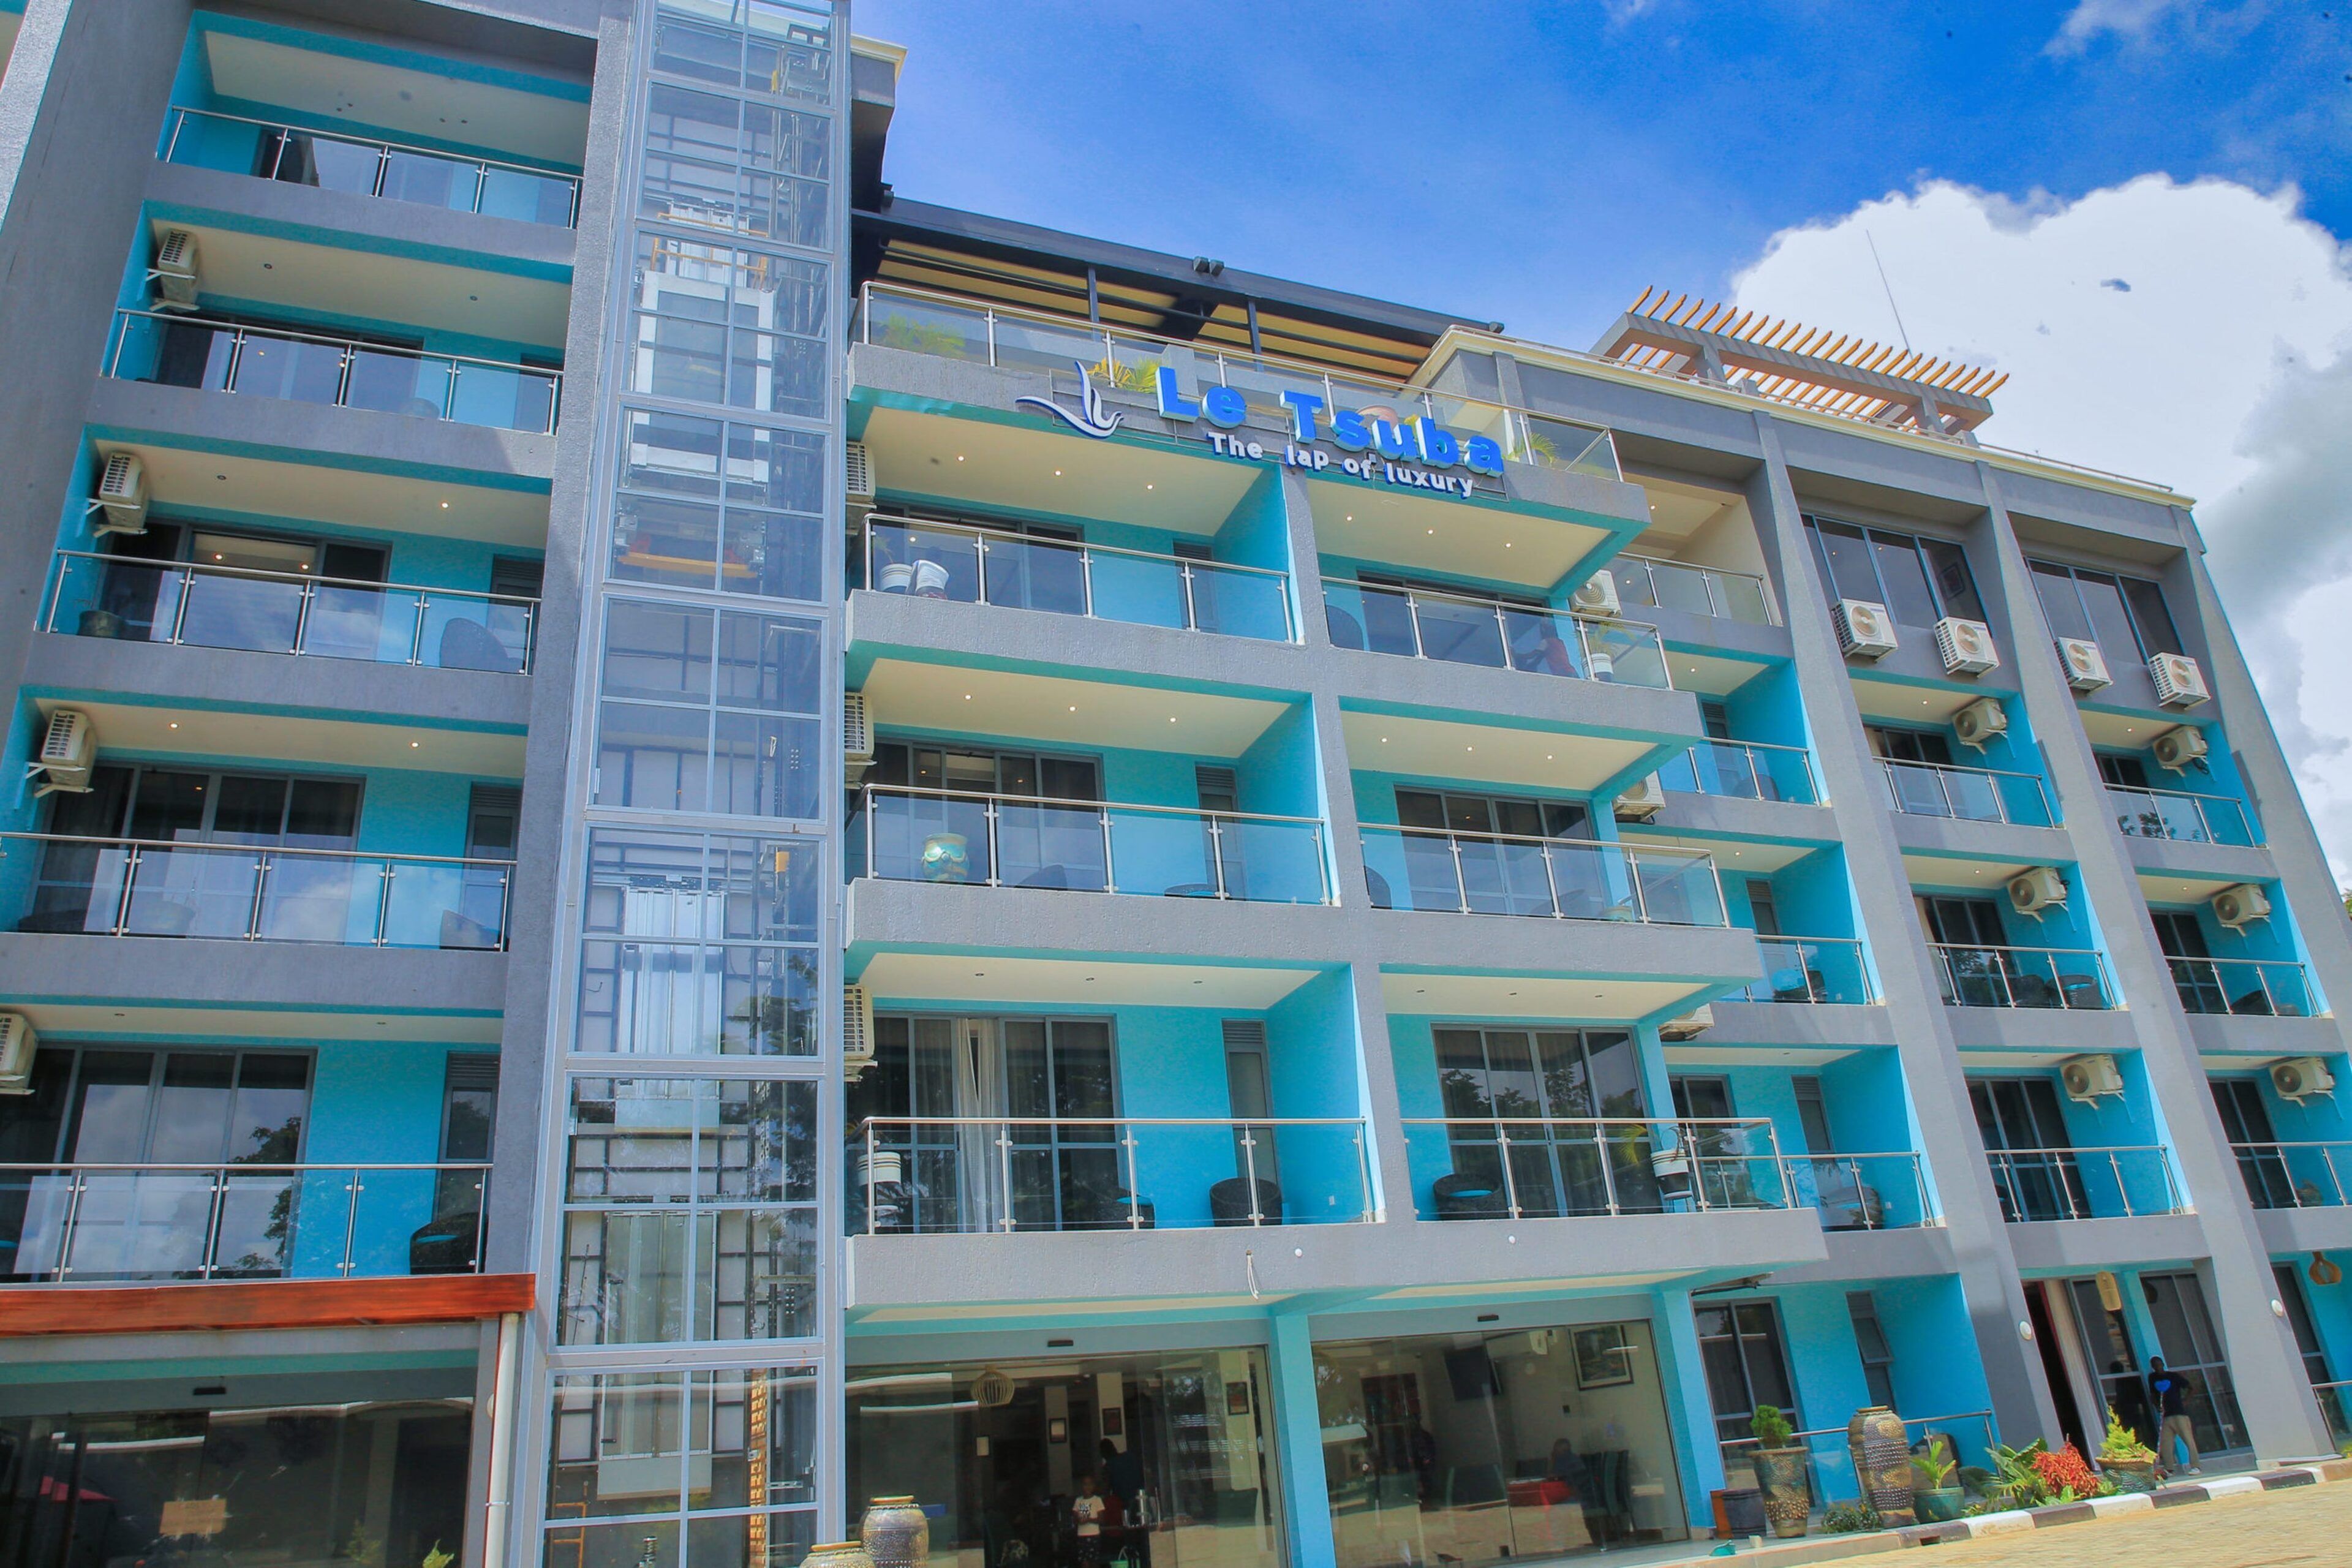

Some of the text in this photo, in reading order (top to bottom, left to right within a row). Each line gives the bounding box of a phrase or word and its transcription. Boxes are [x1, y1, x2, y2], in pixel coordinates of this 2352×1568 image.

[1155, 366, 1504, 478] Le Tsuba
[1207, 431, 1474, 500] The lap of luxury
